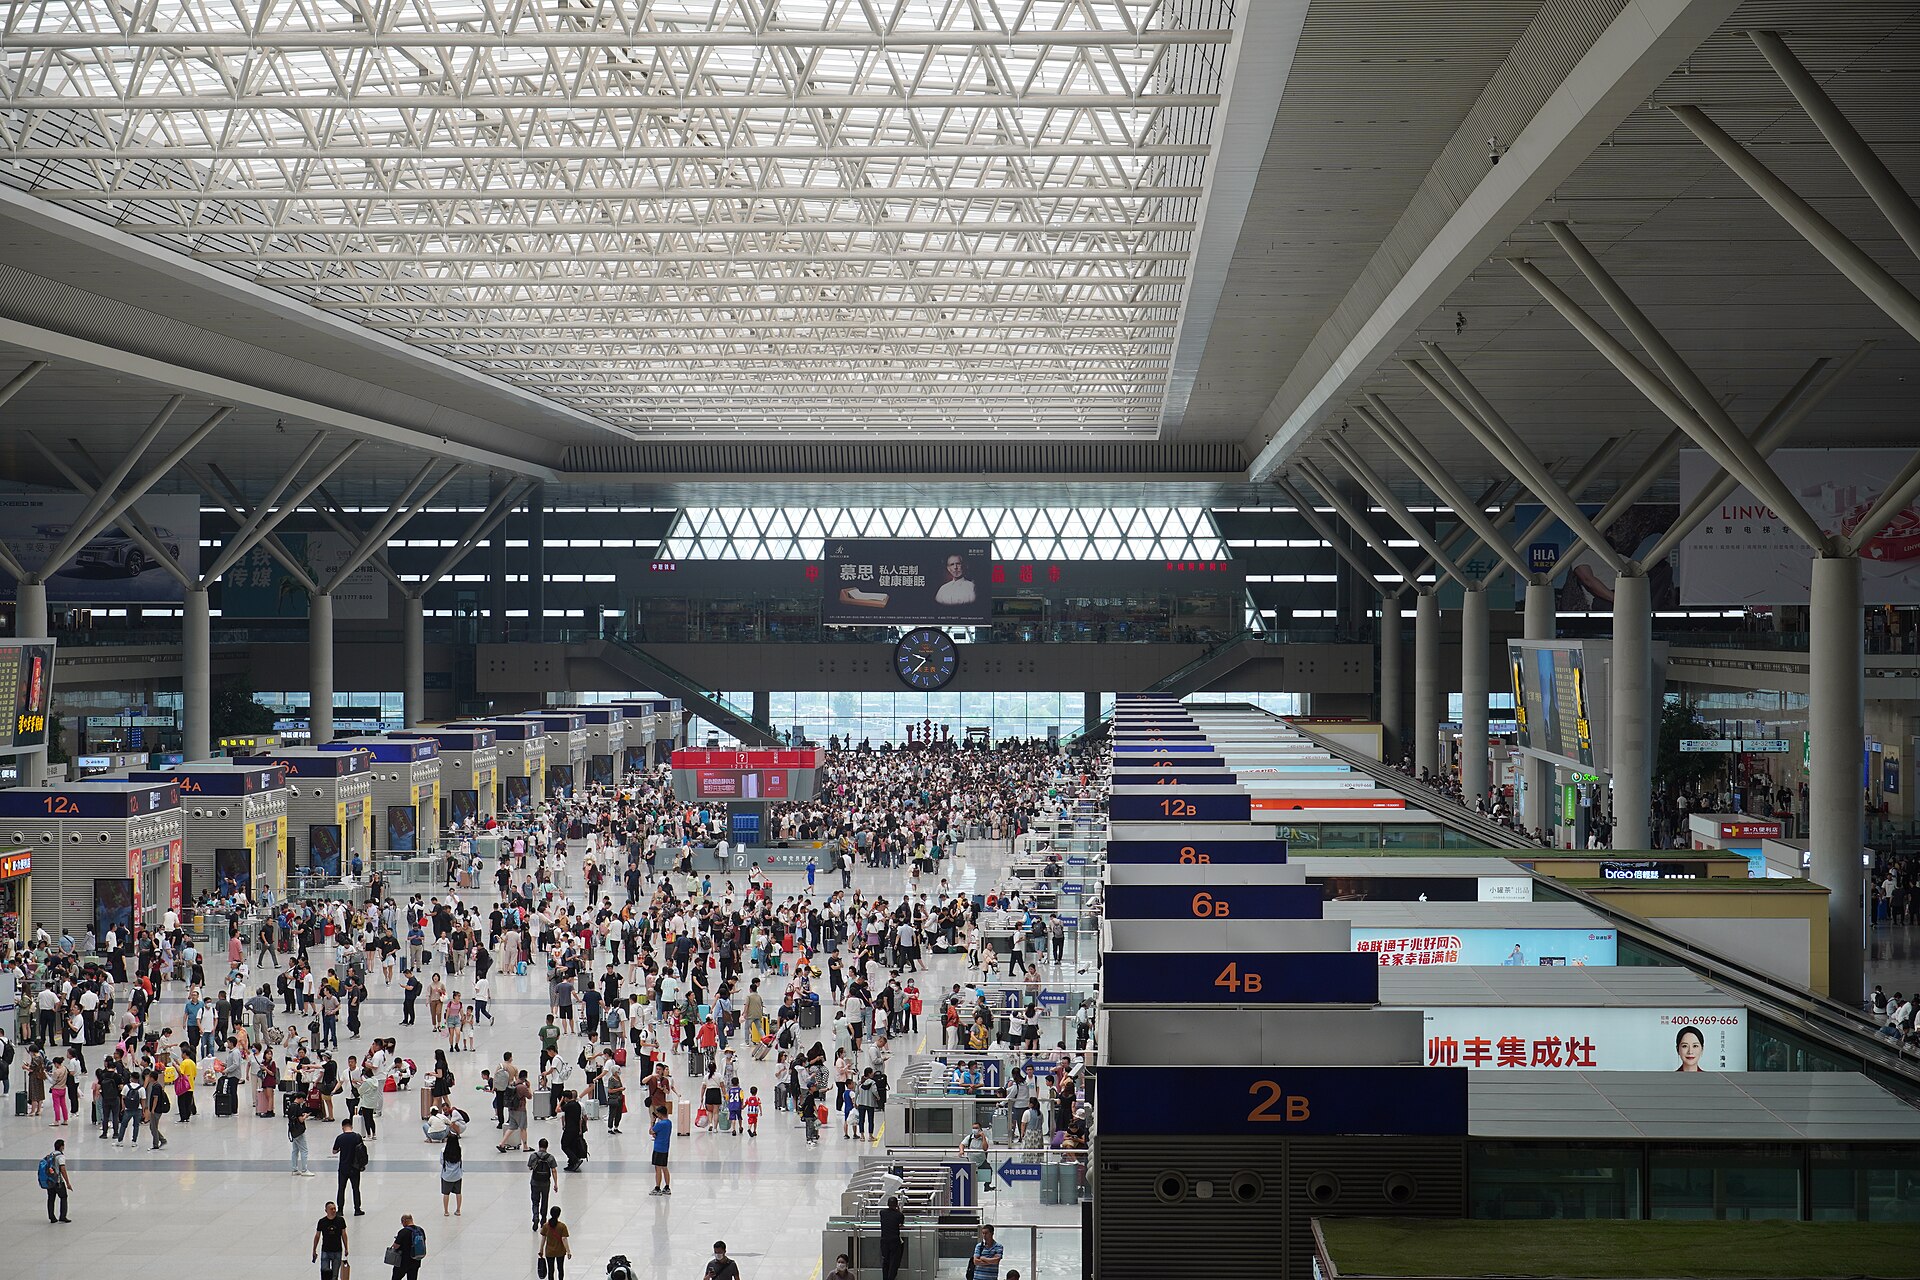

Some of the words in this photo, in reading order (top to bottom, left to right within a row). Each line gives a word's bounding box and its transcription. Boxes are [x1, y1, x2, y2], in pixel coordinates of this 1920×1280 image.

[1533, 550, 1555, 560] HLA
[840, 565, 874, 580] 慕思
[879, 565, 919, 575] 私人定制
[879, 575, 926, 587] 健康睡眠
[43, 796, 80, 814] 12A
[1160, 799, 1197, 816] 12B
[1604, 868, 1634, 880] breo
[1489, 886, 1511, 894] 小罐茶
[1515, 886, 1530, 894] 出品
[1191, 892, 1230, 917] 6B
[1356, 936, 1450, 953] 换联通千兆好网
[1378, 951, 1458, 967] 全家幸福满格
[1214, 962, 1263, 993] 4B
[1670, 1015, 1739, 1025] 400-6969-666
[1428, 1035, 1598, 1068] 帅丰集成灶
[1247, 1080, 1311, 1122] 2B
[1003, 1168, 1039, 1176] 中转换乘通道
